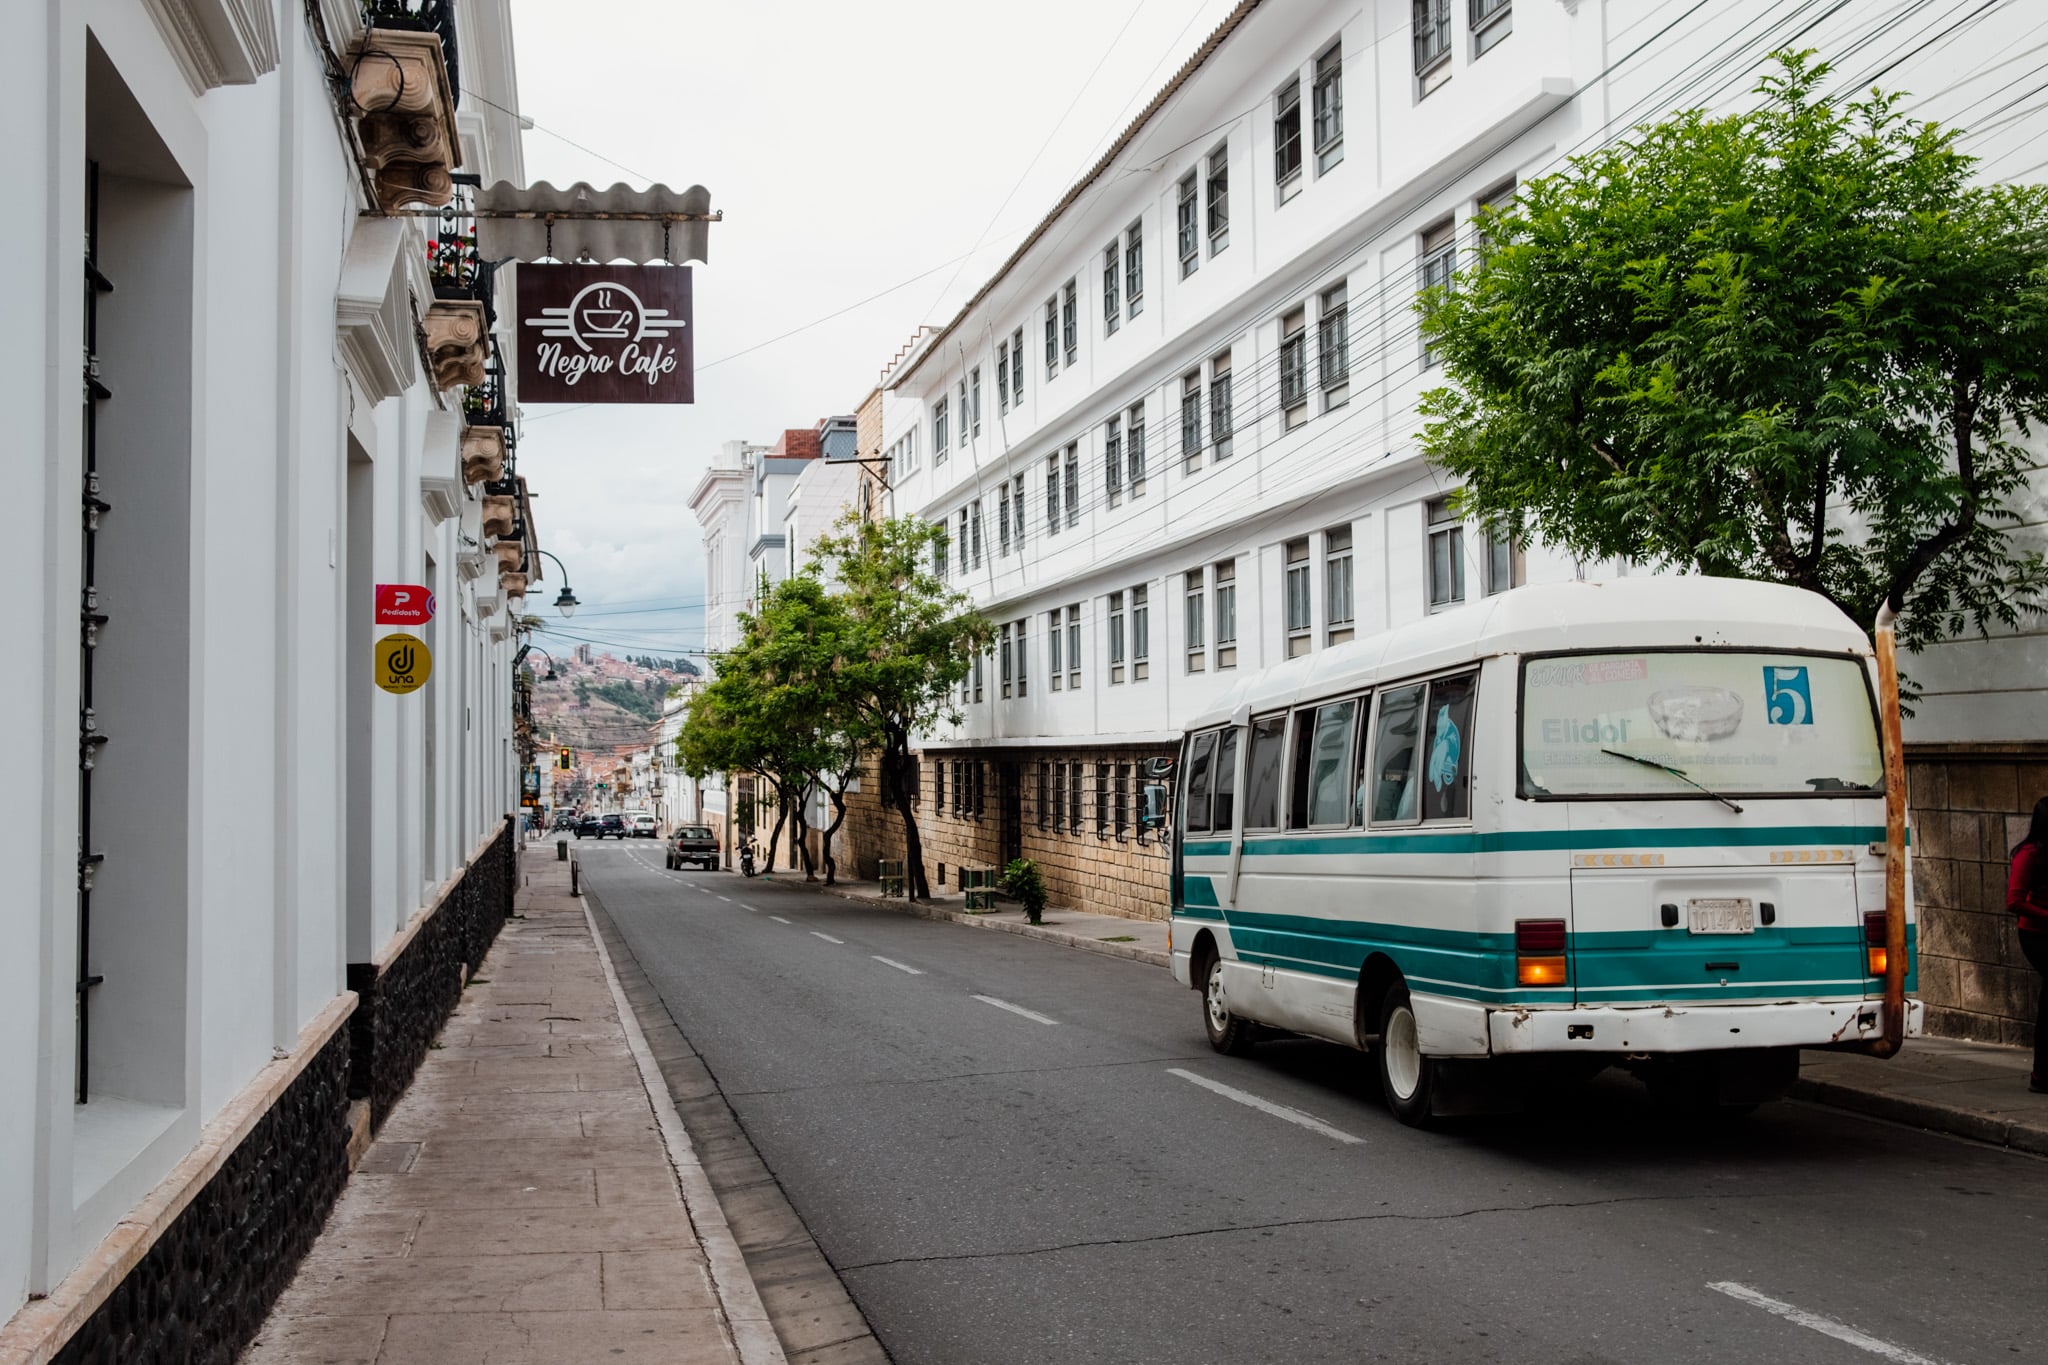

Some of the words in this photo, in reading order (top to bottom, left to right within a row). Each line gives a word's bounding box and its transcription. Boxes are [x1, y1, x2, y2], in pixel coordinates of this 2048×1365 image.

[537, 342, 614, 385] Negro
[619, 343, 677, 385] Café
[381, 608, 421, 617] PedidosYa
[388, 675, 415, 684] una
[1770, 667, 1807, 725] 5
[1542, 719, 1627, 743] Elidol
